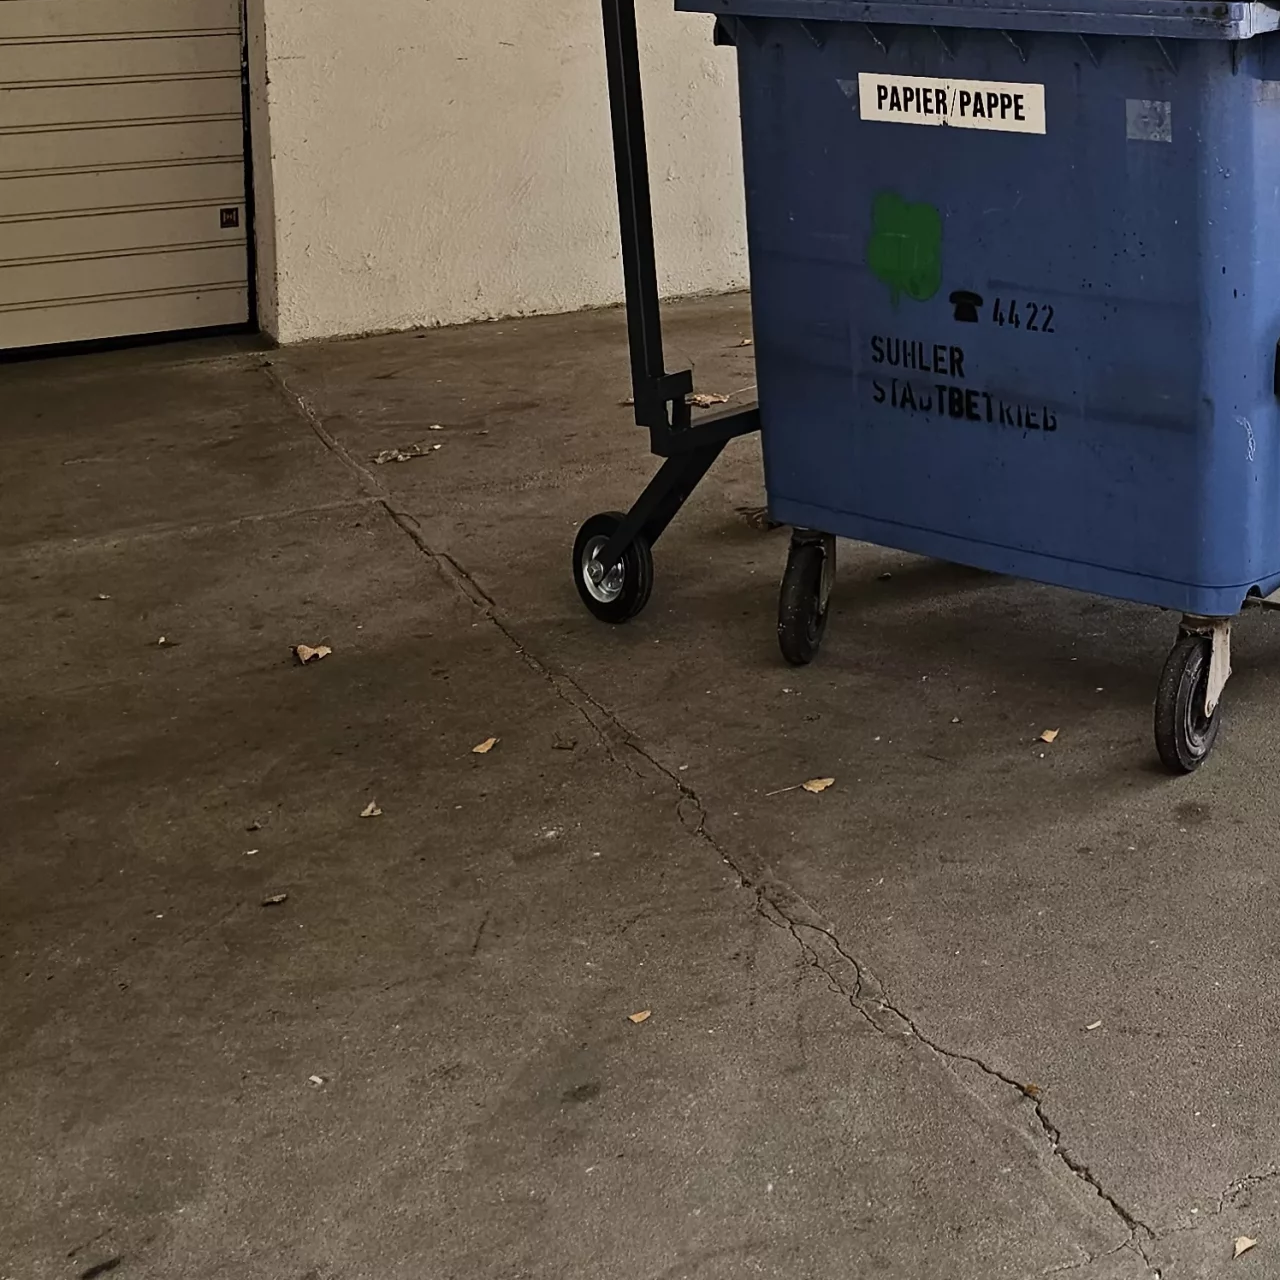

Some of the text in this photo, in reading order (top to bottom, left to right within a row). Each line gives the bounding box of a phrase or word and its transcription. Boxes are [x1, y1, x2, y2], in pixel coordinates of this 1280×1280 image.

[877, 85, 1026, 120] PAPIER/PAPPE
[992, 298, 1055, 333] 4422
[871, 335, 965, 378] SUHLER
